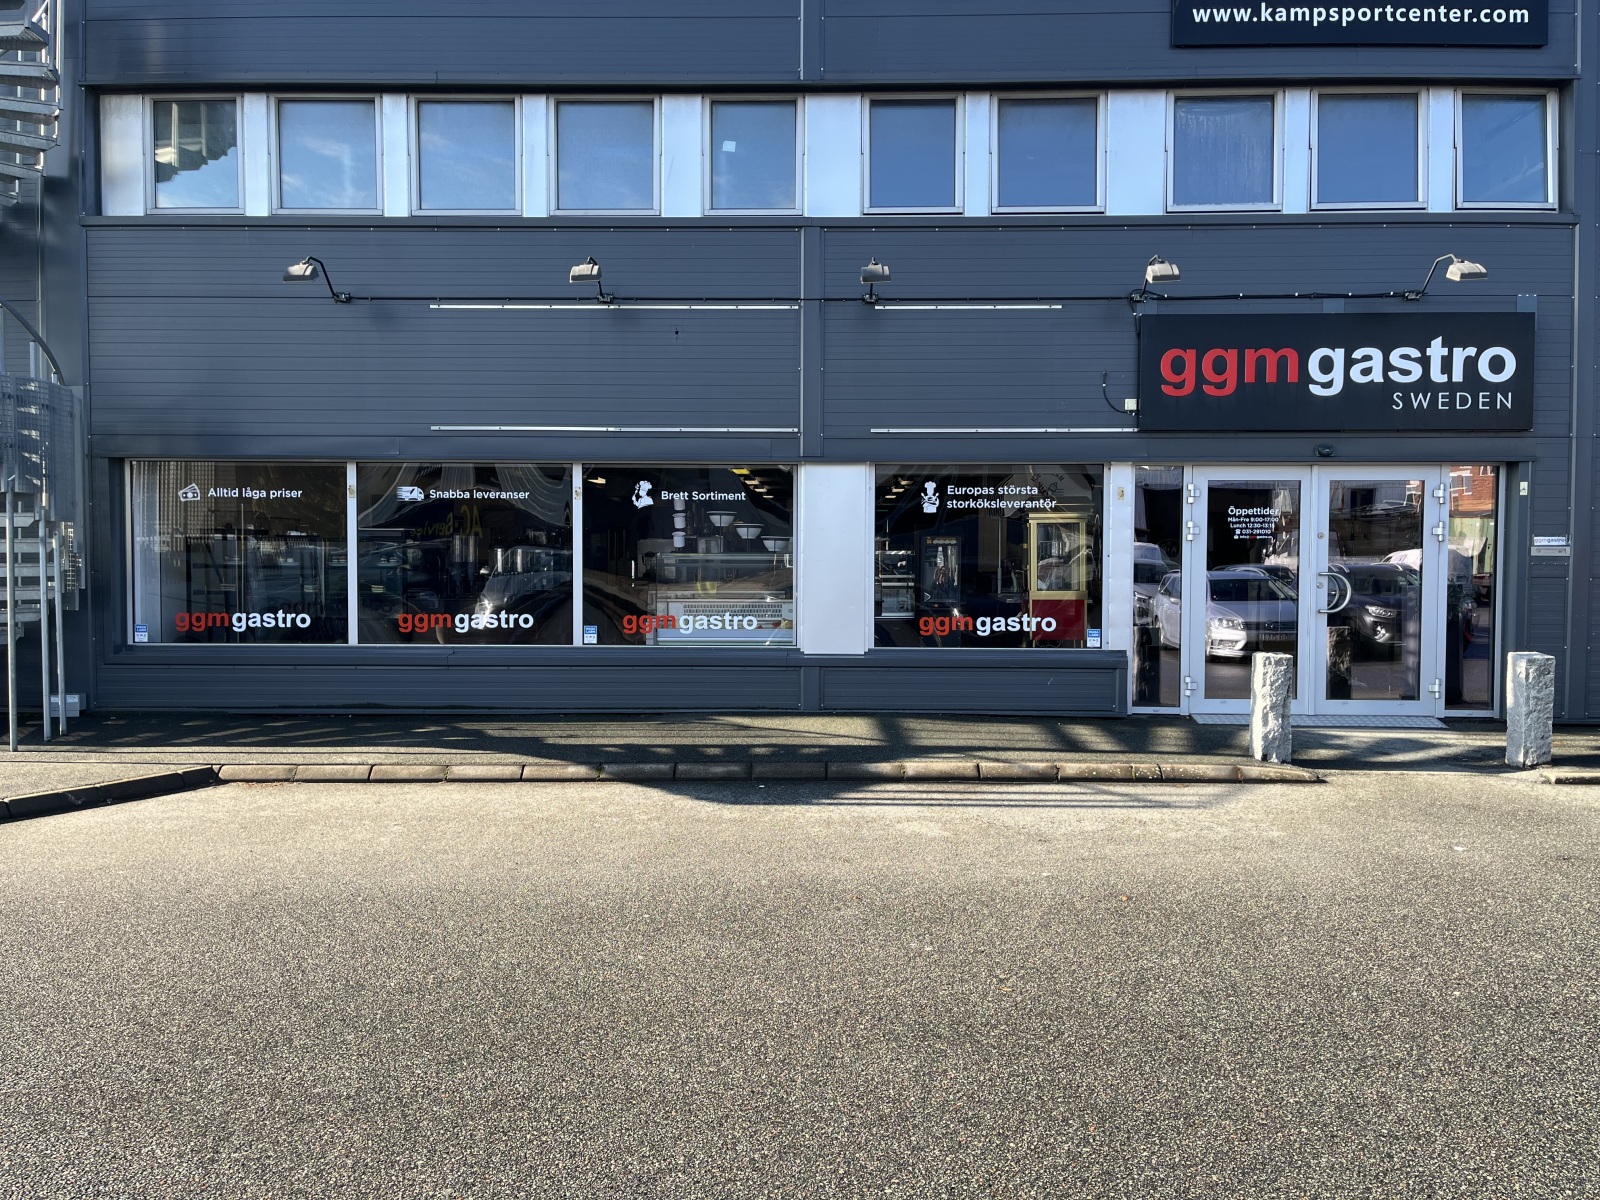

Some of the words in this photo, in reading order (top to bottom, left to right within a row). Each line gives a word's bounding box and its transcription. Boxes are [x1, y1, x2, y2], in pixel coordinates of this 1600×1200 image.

[1192, 2, 1530, 27] www.kampsportcenter.com
[1392, 391, 1513, 410] SWEDEN
[207, 487, 239, 498] Alltid
[242, 487, 267, 500] låga
[269, 488, 303, 500] priser
[429, 488, 471, 499] Snabba
[473, 489, 530, 500] leveranser
[661, 490, 689, 501] Brett
[691, 490, 746, 501] Sortiment
[947, 485, 995, 497] Europas
[997, 484, 1039, 495] största
[946, 498, 1057, 509] storköksleverantör
[1228, 506, 1279, 516] Öppettider
